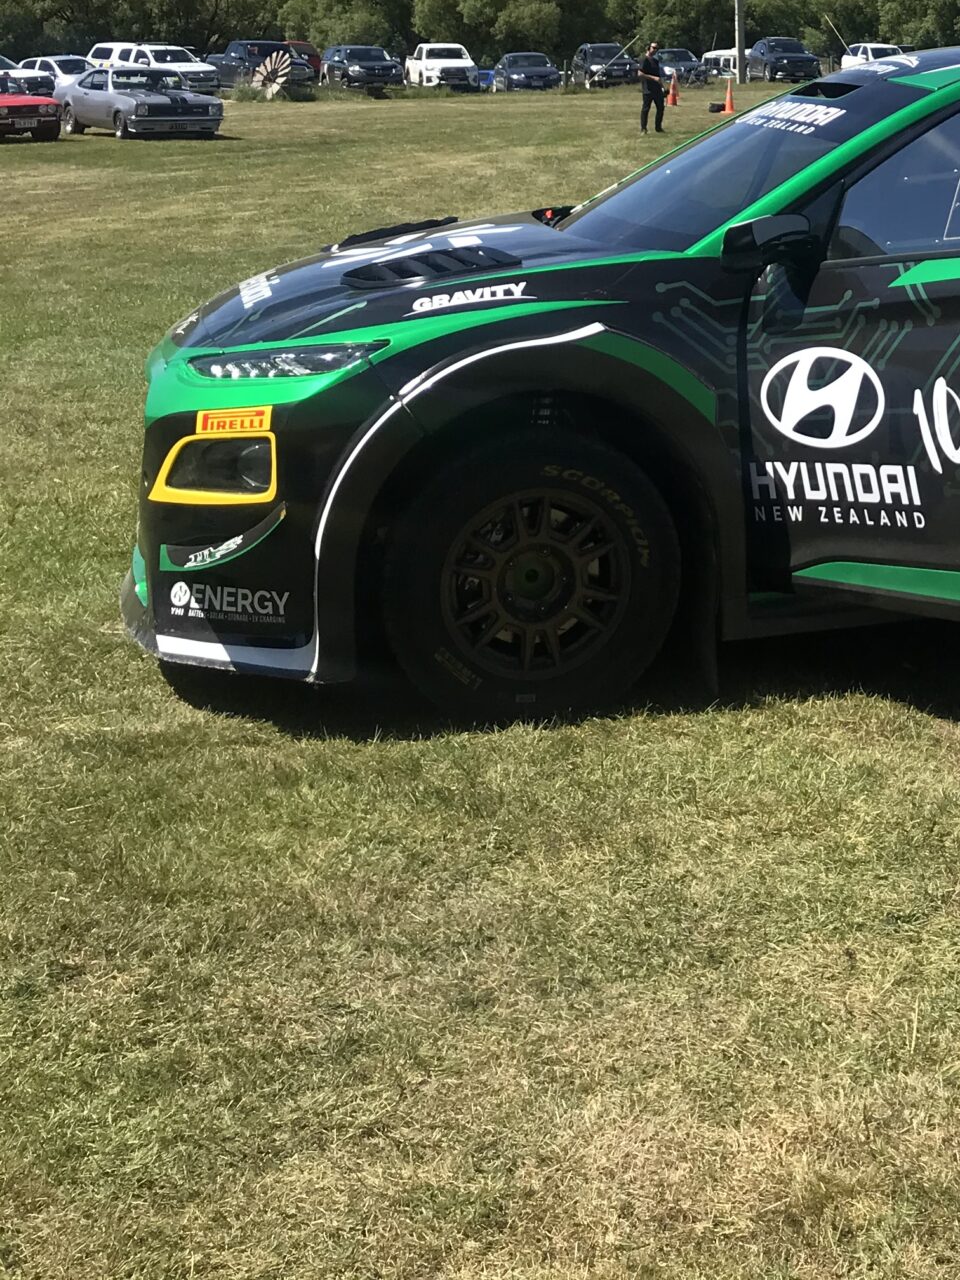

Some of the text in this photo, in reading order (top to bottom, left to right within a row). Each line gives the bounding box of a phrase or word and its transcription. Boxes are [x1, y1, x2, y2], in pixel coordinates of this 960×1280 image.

[763, 119, 816, 135] ZEALAND
[412, 281, 527, 312] GRAVITY
[201, 410, 265, 431] PIRELLI
[749, 461, 922, 506] HYUNDAI
[755, 505, 926, 529] NEW ZEALAND
[190, 583, 290, 615] ENERGY
